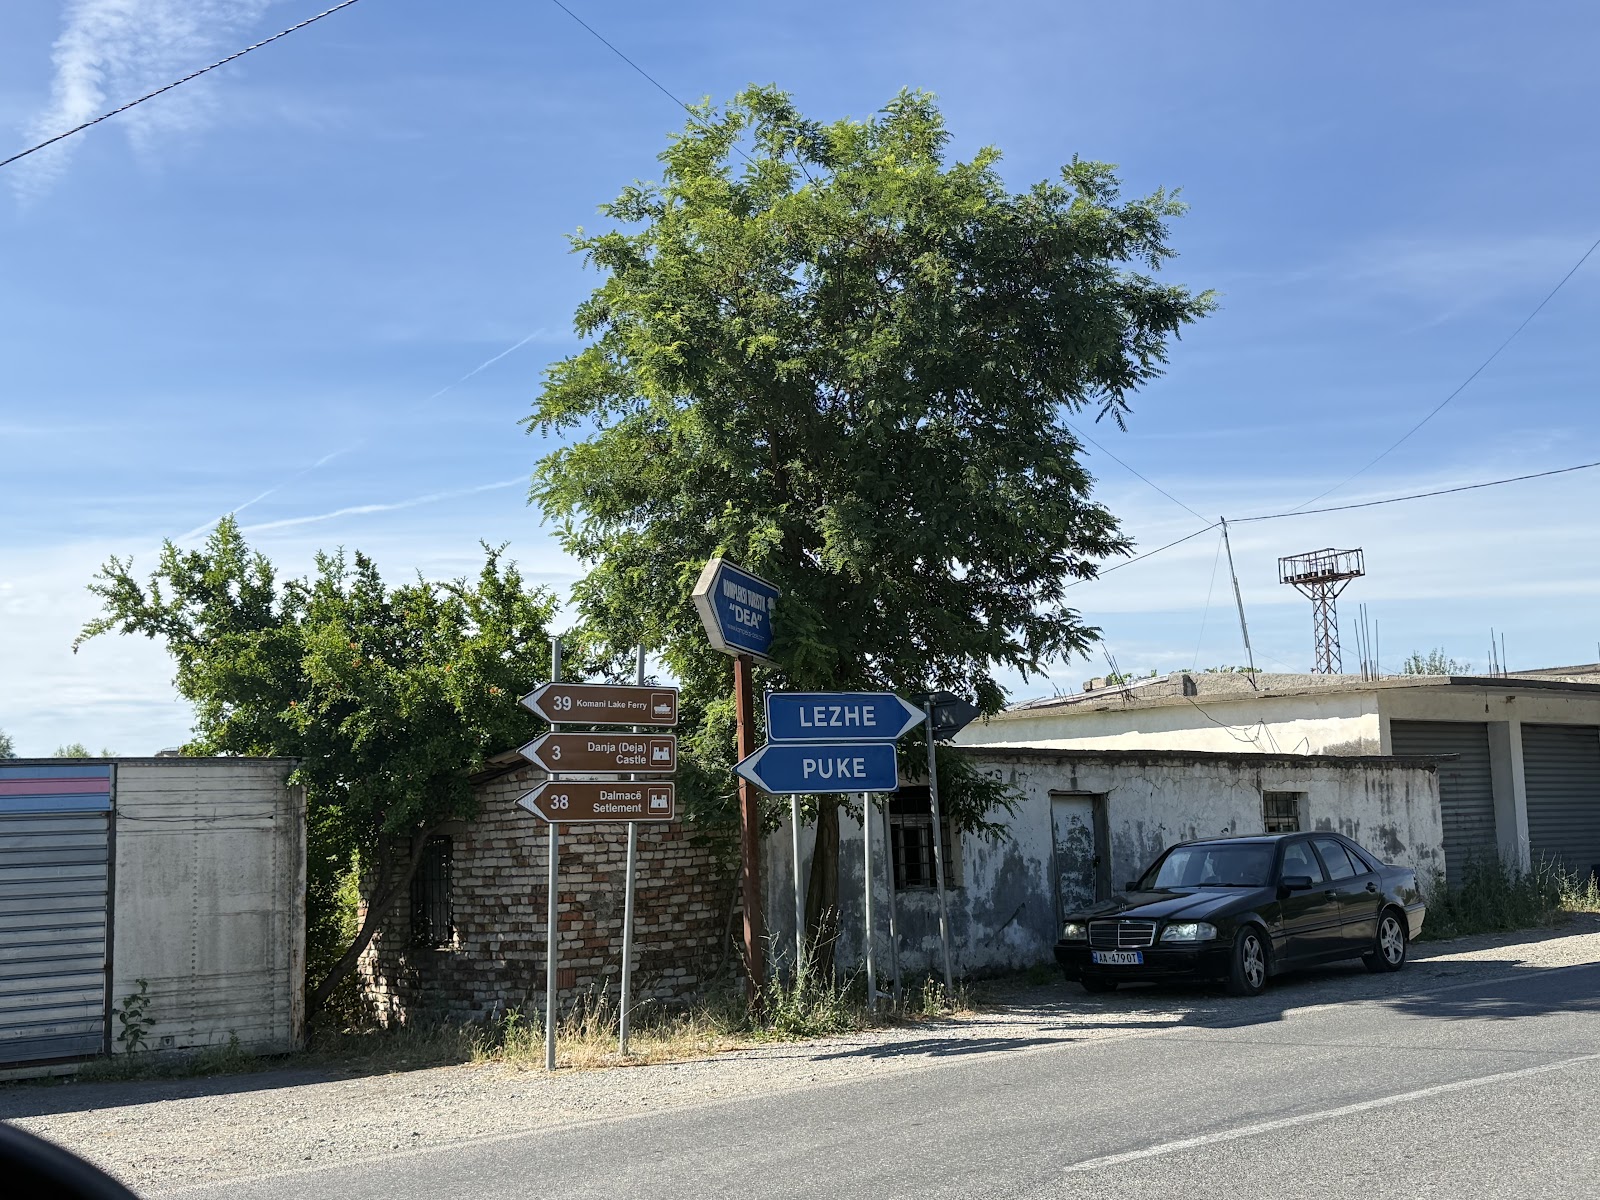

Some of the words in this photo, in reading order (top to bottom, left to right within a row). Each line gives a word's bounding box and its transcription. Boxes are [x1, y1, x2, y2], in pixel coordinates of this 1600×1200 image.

[553, 696, 572, 711] 39
[576, 700, 606, 708] Komani
[608, 701, 626, 709] Lake
[627, 702, 648, 711] Ferry
[800, 706, 877, 727] LEZHE
[551, 746, 562, 760] 3
[587, 742, 616, 754] Danja
[619, 743, 647, 754] (Deja)
[616, 755, 647, 764] Castle
[803, 758, 867, 779] PUKE
[550, 794, 569, 810] 38
[600, 790, 642, 800] Dalmacë
[593, 803, 642, 813] Setlement
